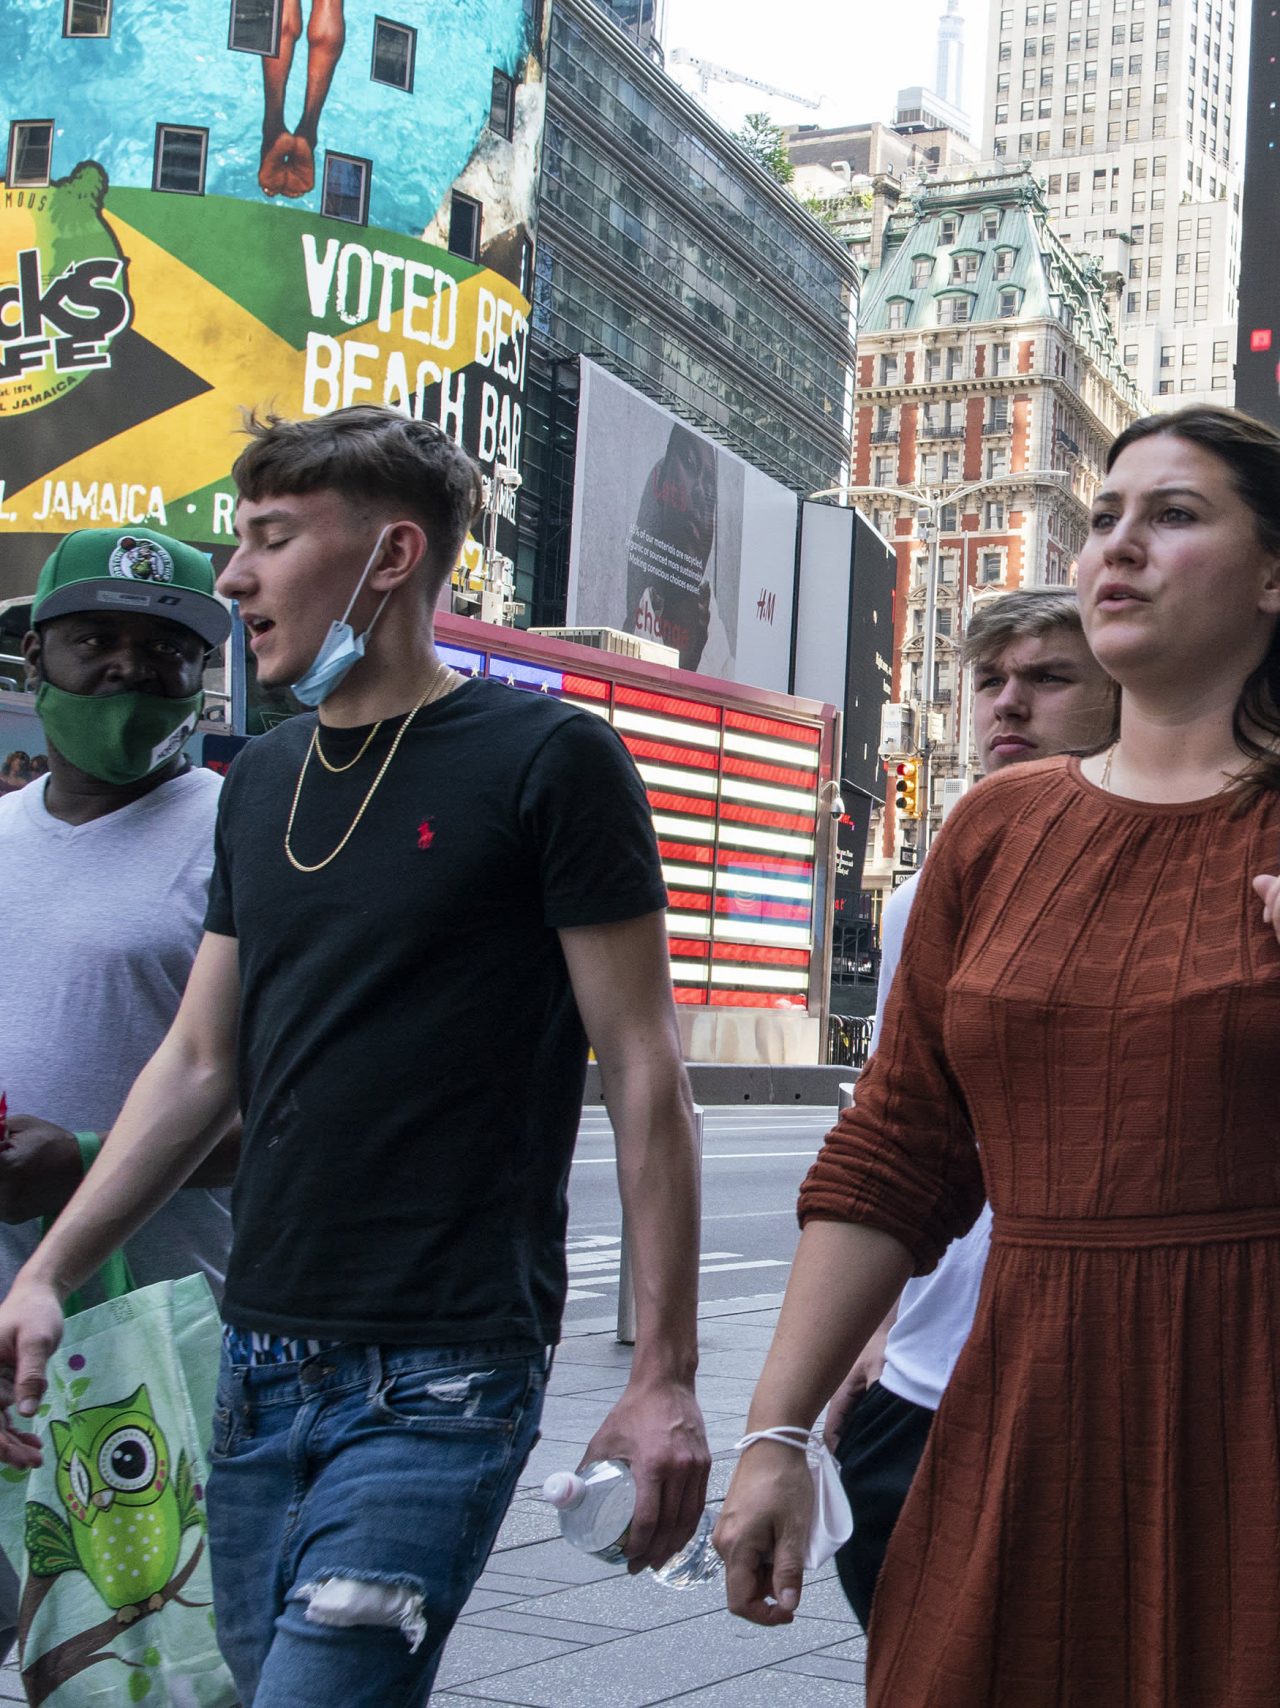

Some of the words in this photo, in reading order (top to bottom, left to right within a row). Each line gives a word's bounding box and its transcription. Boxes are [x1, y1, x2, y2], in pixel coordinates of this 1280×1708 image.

[301, 234, 459, 350] VOTED
[474, 286, 529, 392] BEST
[0, 337, 111, 382] FE
[12, 375, 77, 410] JAMAICA
[302, 331, 466, 447] BEACH
[478, 381, 522, 473] BAR
[32, 479, 168, 526] JAMAICA
[647, 562, 669, 581] conscious
[669, 573, 686, 589] choices
[757, 588, 776, 626] H&M
